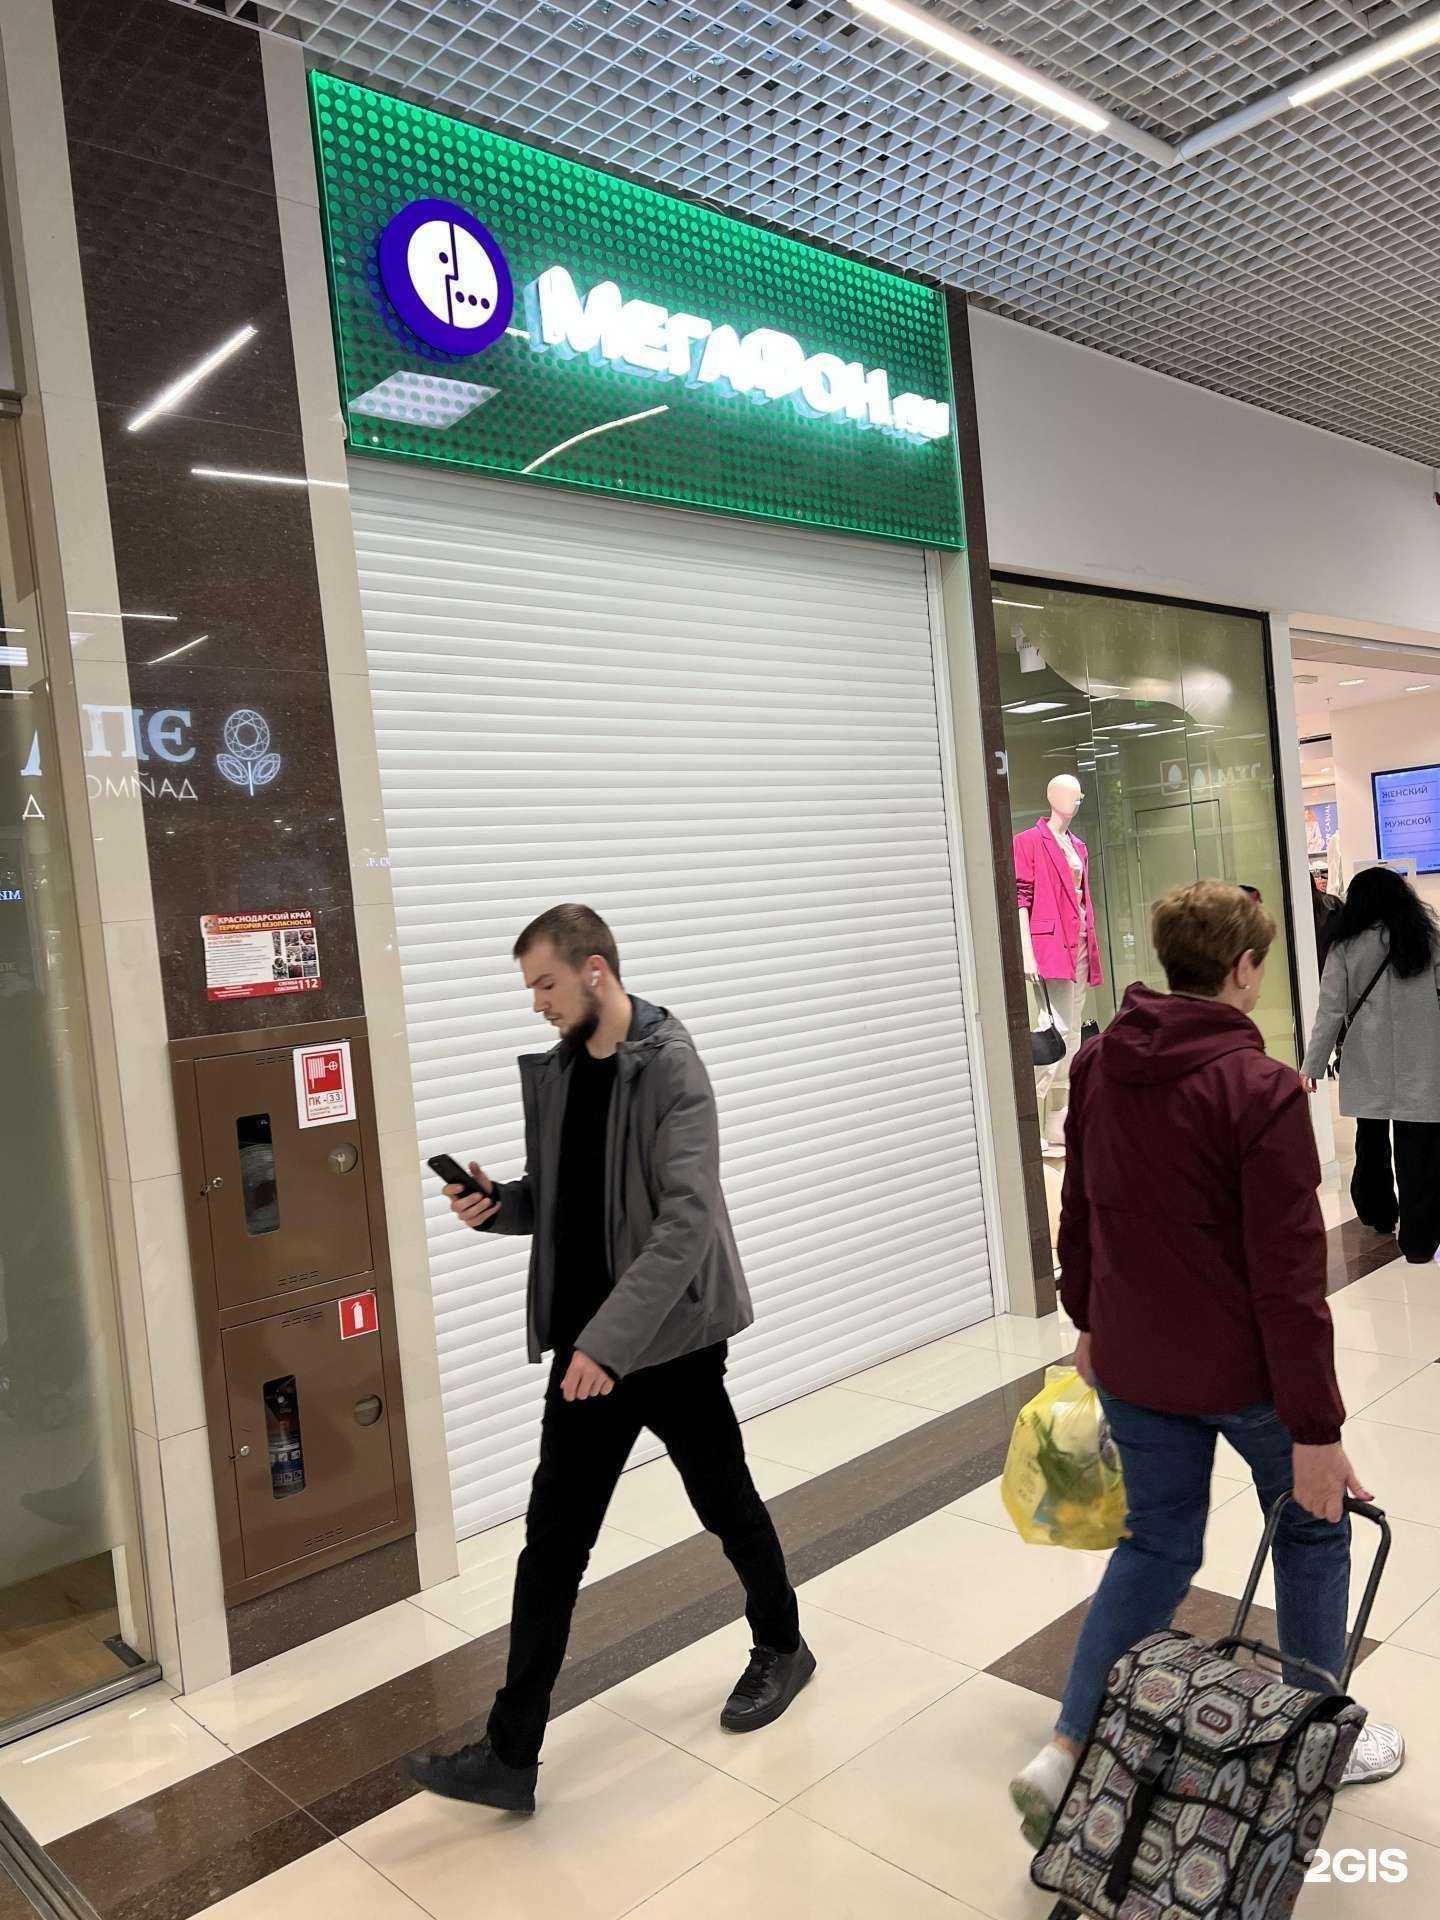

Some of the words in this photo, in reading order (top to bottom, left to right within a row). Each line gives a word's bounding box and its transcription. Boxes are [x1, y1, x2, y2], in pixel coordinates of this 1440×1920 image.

[1382, 784, 1429, 799] ЖЕНСКИЙ
[1384, 815, 1432, 829] МУЖСКОЙ
[218, 911, 289, 924] КРАСНОДАРСКИЙ
[290, 910, 311, 919] КРАЙ
[219, 921, 262, 931] ТЕРРИТОРИЯ
[262, 919, 312, 928] БЕЗОПАСНОСТИ
[298, 978, 319, 990] 112
